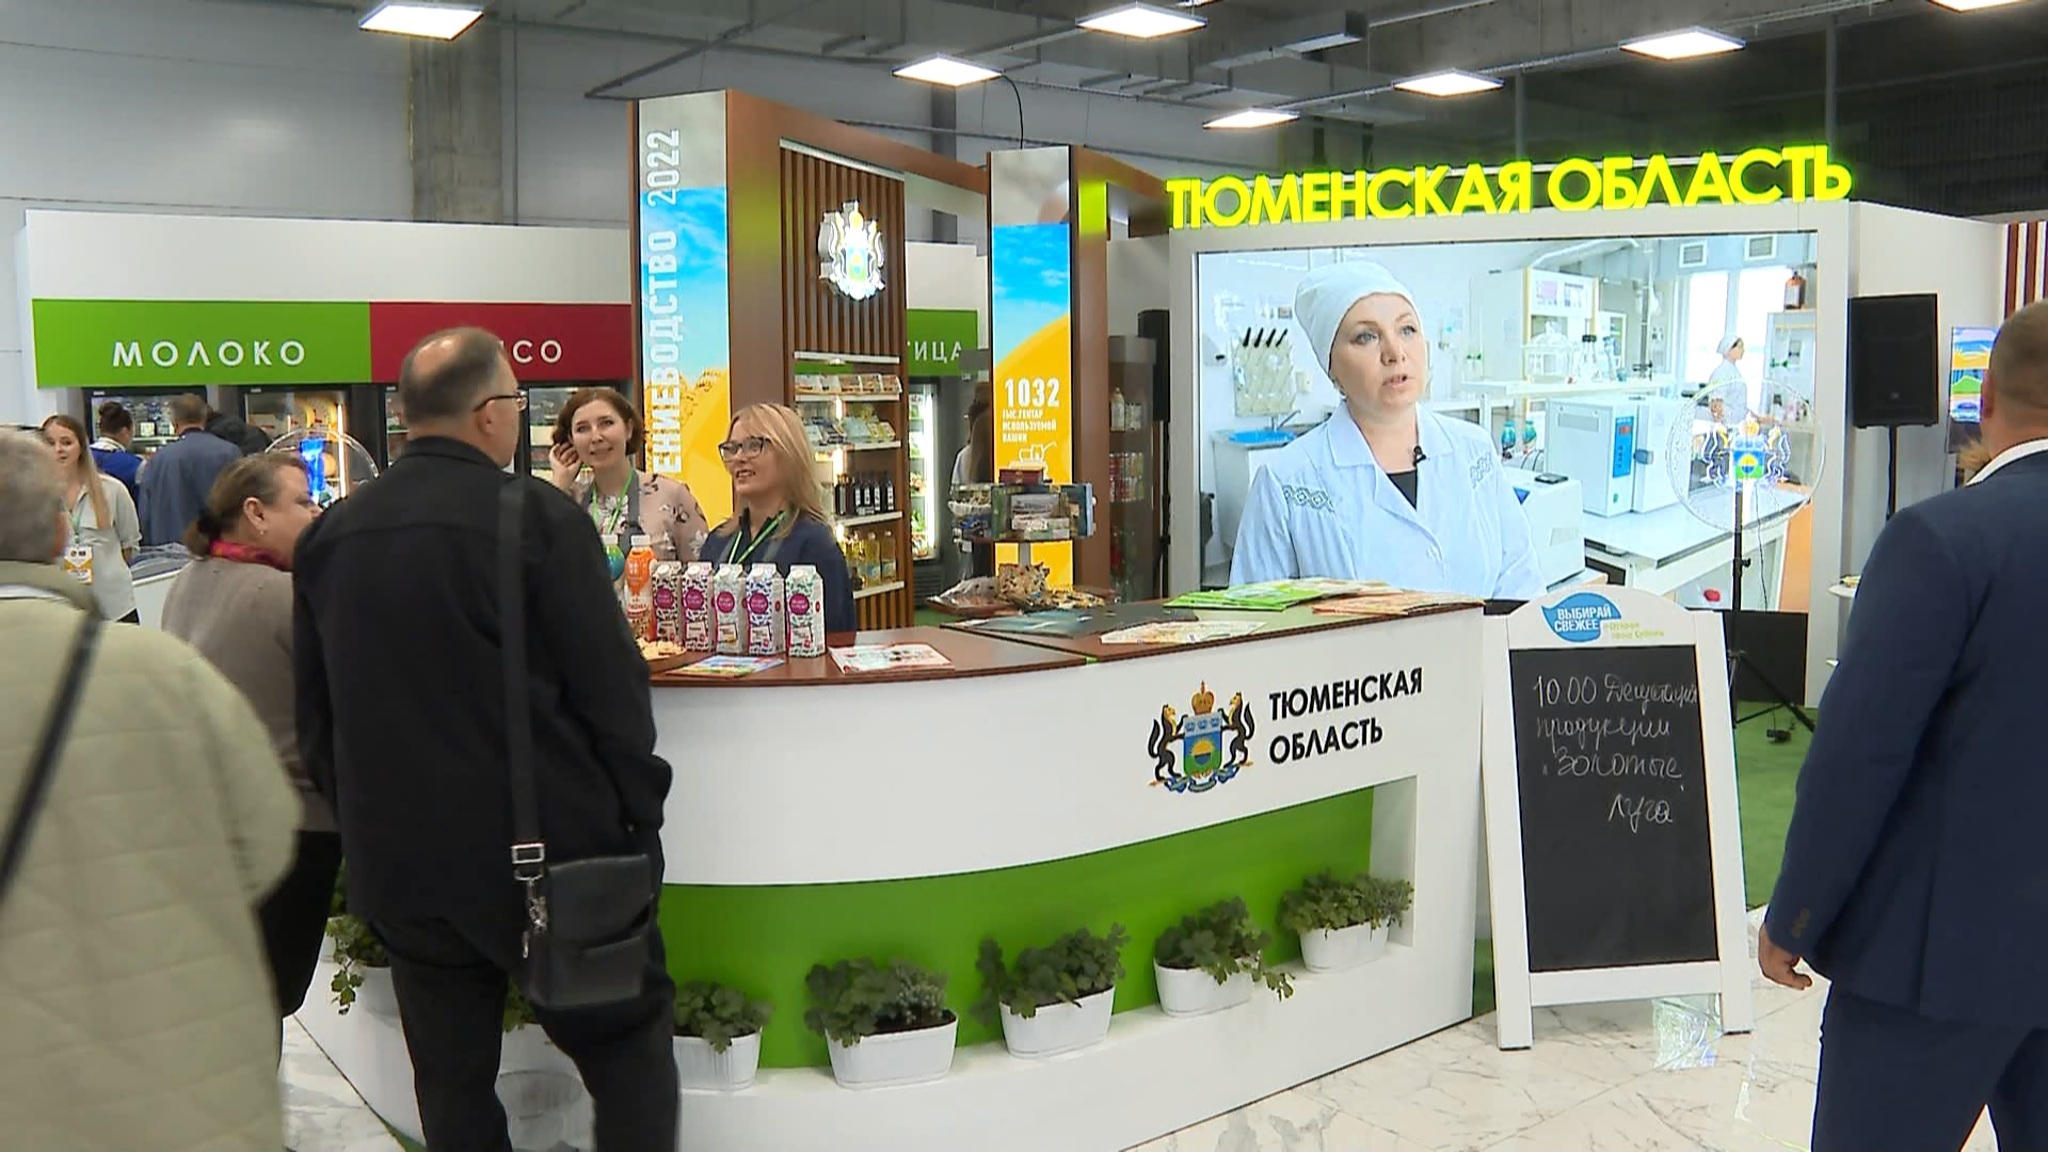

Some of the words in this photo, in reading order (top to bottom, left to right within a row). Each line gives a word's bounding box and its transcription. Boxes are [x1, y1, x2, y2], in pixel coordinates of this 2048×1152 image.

[646, 129, 680, 208] 2022
[1166, 160, 1533, 230] ТЮМЕНСКАЯ
[1546, 144, 1852, 213] ОБЛАСТЬ
[112, 340, 305, 367] МОЛОКО
[499, 339, 562, 363] СО
[645, 230, 684, 474] ЕНИЕВОДСТВО
[907, 341, 962, 364] ИЦА
[1005, 377, 1060, 408] 1032
[1554, 619, 1600, 632] СВЕЖЕЕ
[1557, 605, 1612, 620] ВЫБИРАЙ
[1269, 667, 1423, 721] ТЮМЕНСКАЯ
[1269, 717, 1384, 765] ОБЛАСТЬ
